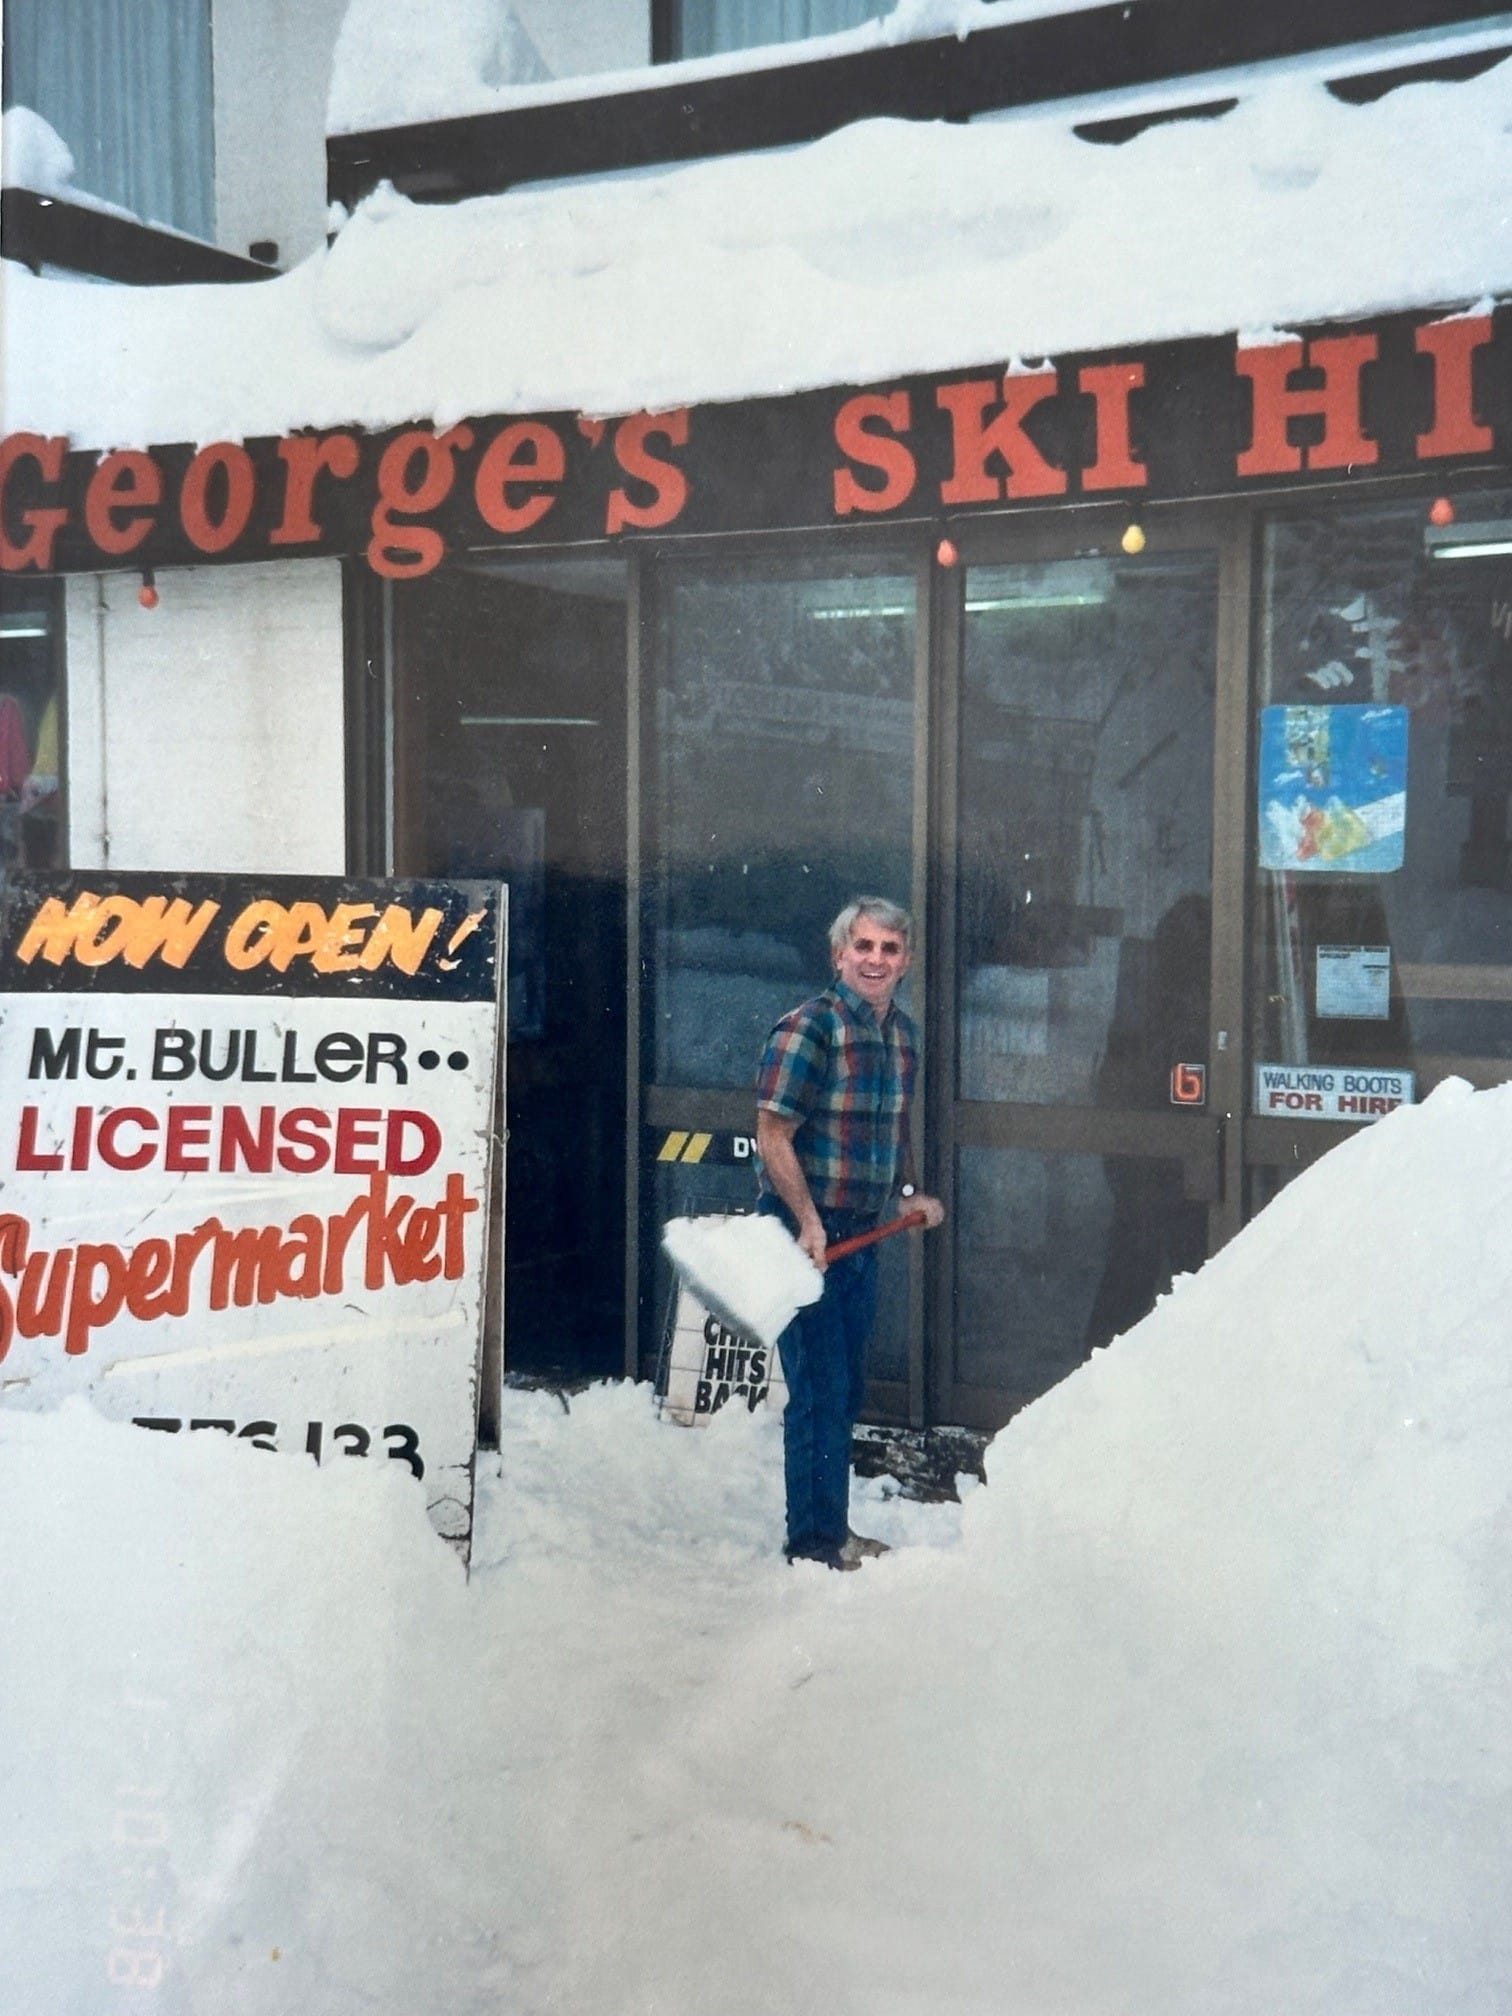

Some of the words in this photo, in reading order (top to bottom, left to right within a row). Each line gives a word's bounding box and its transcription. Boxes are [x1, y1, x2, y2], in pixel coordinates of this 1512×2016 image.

[834, 363, 1148, 515] SKI
[17, 892, 220, 969] NOW
[225, 900, 488, 976] OPEN!
[28, 1028, 136, 1080] Mt.
[1264, 1071, 1334, 1090] WALKING
[1344, 1077, 1402, 1094] BOOTS
[1269, 1092, 1323, 1111] FOR
[16, 1106, 442, 1176] LICENSED
[0, 1172, 479, 1364] Supermarket
[705, 1348, 767, 1385] HITS
